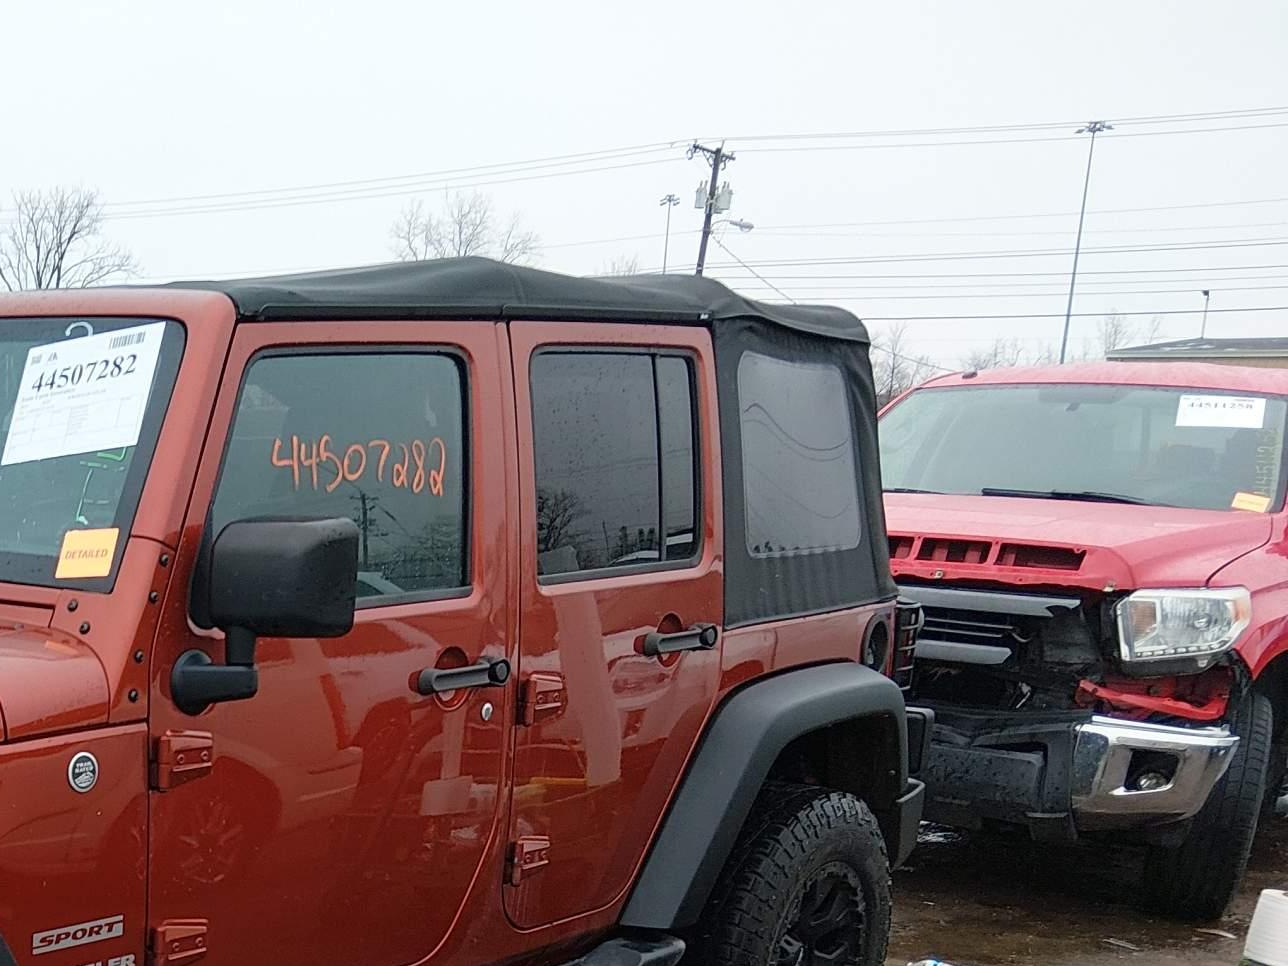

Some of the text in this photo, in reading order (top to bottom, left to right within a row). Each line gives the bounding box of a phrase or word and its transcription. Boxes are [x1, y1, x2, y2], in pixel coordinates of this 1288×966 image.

[32, 354, 137, 392] 44507282
[272, 435, 445, 497] 44507282
[65, 549, 108, 559] DETAILED
[39, 921, 119, 947] SPORT
